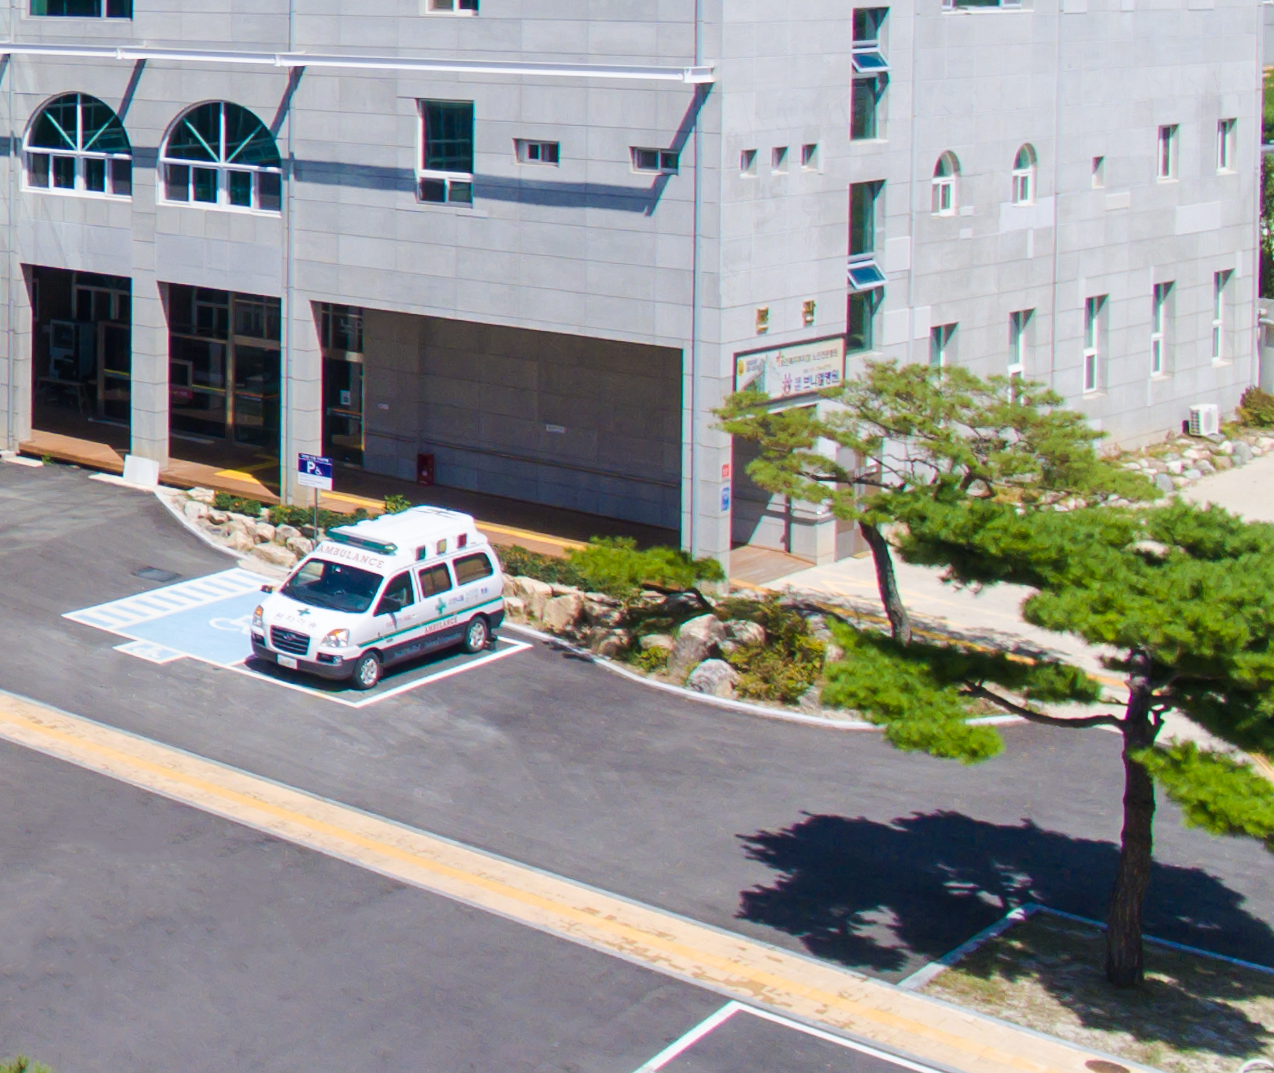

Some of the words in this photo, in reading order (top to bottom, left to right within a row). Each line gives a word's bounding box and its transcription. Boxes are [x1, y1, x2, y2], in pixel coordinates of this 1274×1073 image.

[307, 460, 316, 474] P
[317, 545, 385, 569] AMBULANCE
[425, 616, 457, 633] AMBULANCE
